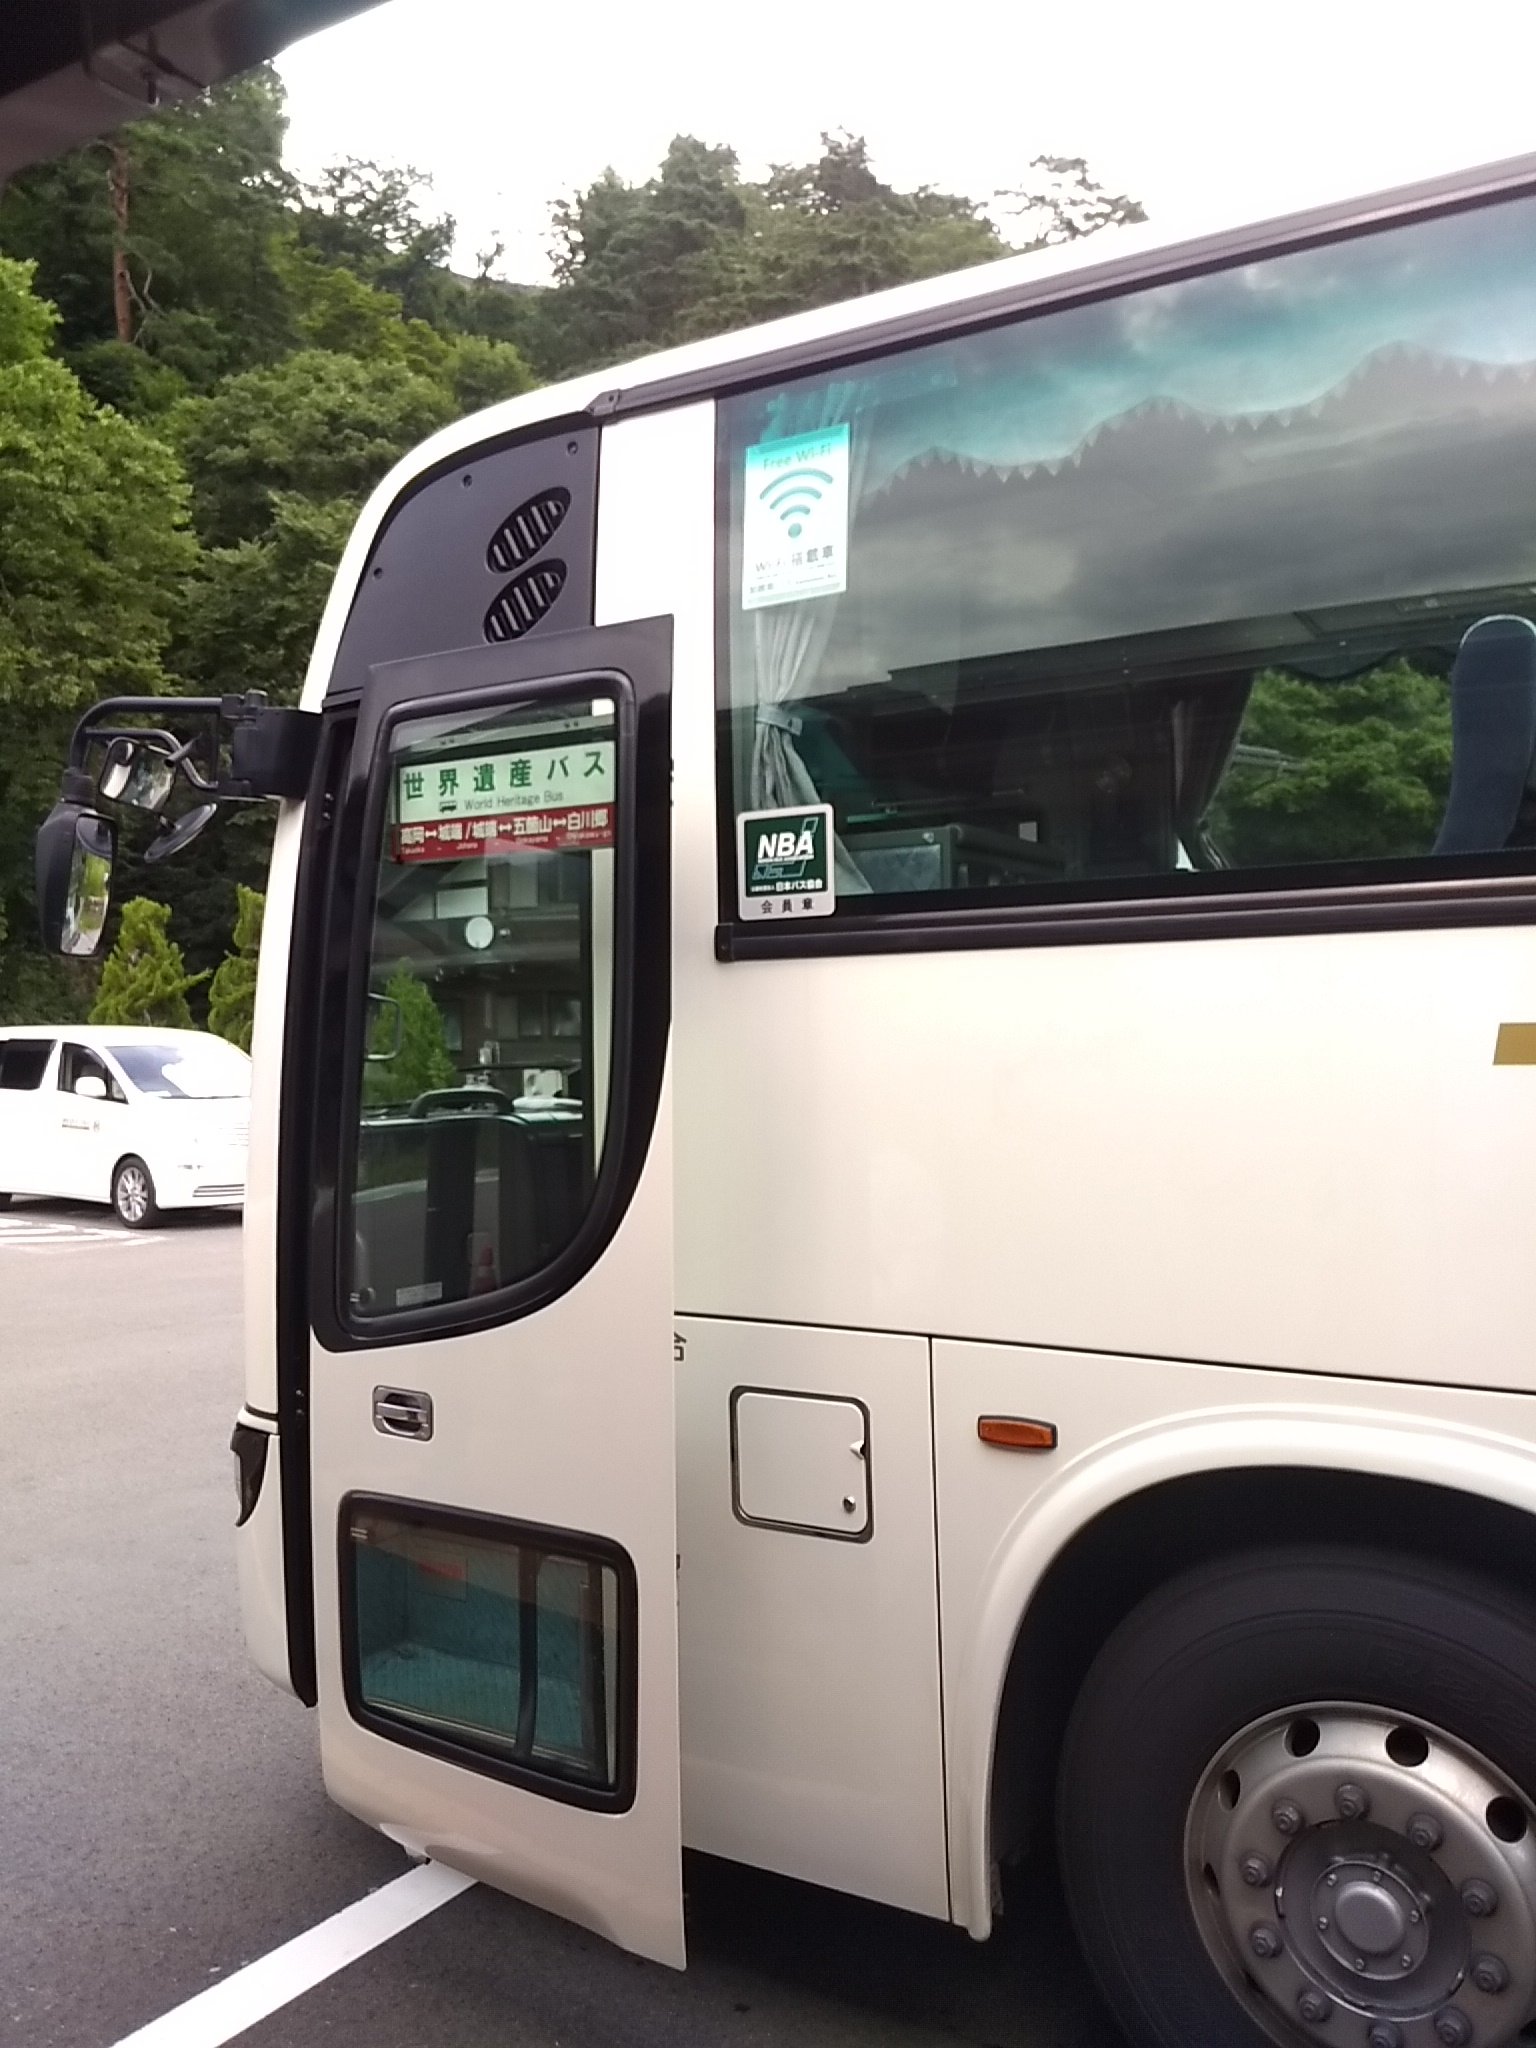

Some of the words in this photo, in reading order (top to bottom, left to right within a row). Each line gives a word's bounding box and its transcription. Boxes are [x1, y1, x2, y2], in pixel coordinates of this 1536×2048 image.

[403, 750, 606, 801] 世界遺産バス
[464, 799, 494, 812] World
[497, 793, 541, 808] Heritage
[543, 790, 564, 804] Bus
[757, 830, 815, 860] NBA
